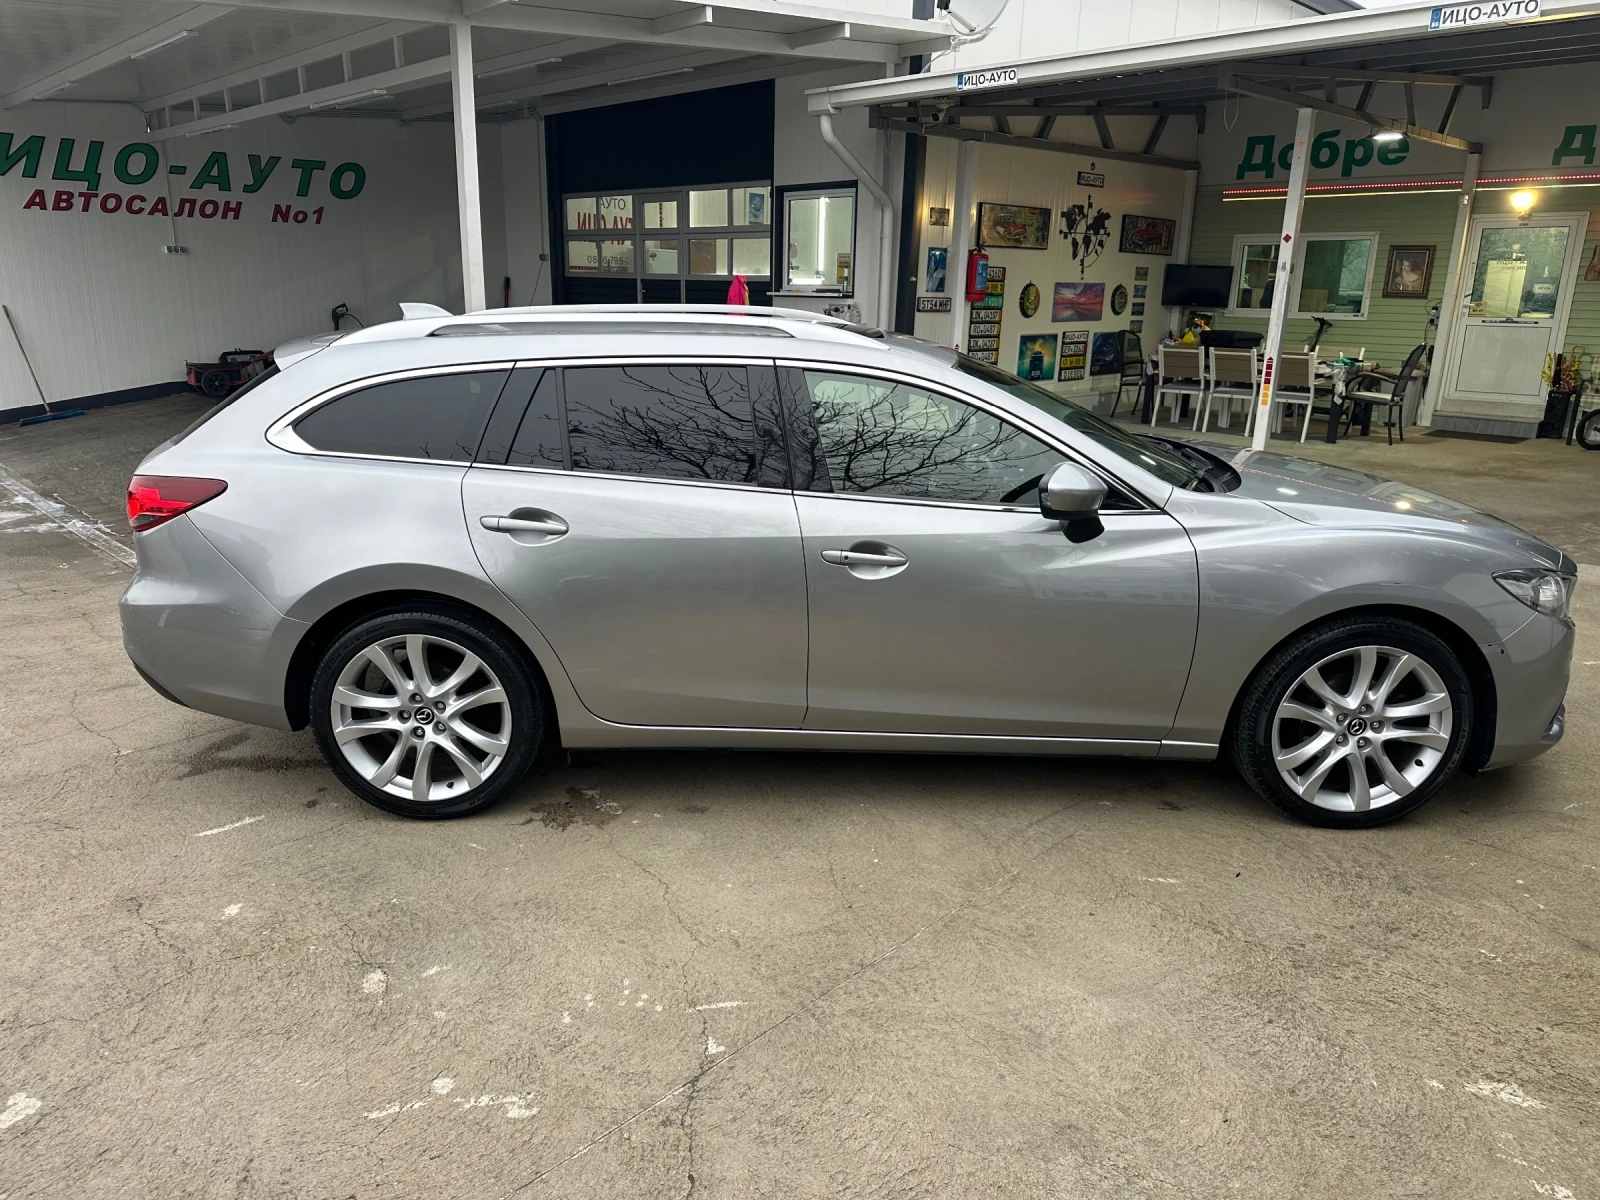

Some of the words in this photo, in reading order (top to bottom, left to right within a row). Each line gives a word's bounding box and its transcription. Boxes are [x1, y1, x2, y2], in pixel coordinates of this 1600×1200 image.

[1442, 0, 1538, 24] ИЦО-АУТО
[964, 70, 1016, 87] ИЦО-АУТО
[0, 132, 366, 200] ИЦО-АУТО
[23, 189, 242, 220] АВТОСАЛОН
[271, 204, 324, 225] No1
[1063, 370, 1084, 379] DIESEL
